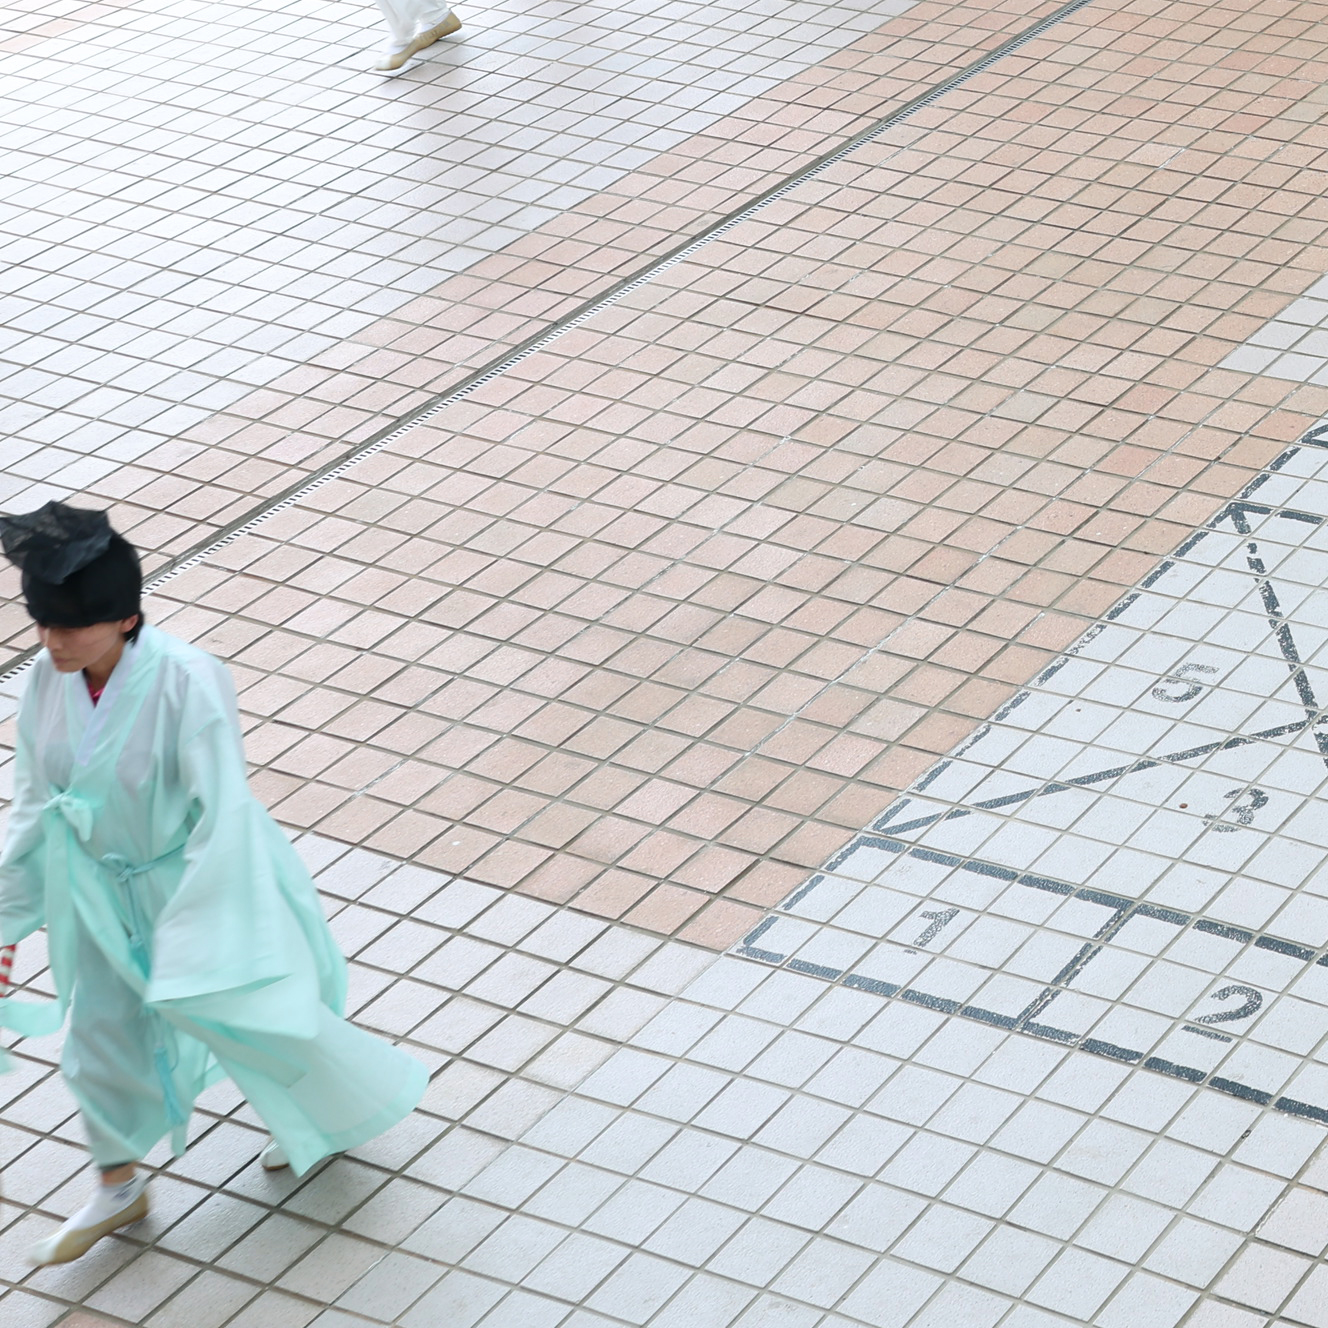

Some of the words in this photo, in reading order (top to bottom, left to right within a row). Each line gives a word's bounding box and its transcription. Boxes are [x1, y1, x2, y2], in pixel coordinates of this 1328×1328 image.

[1151, 662, 1220, 703] 5
[1199, 787, 1270, 834] 3
[904, 907, 961, 955] 1
[1183, 984, 1264, 1044] 2
